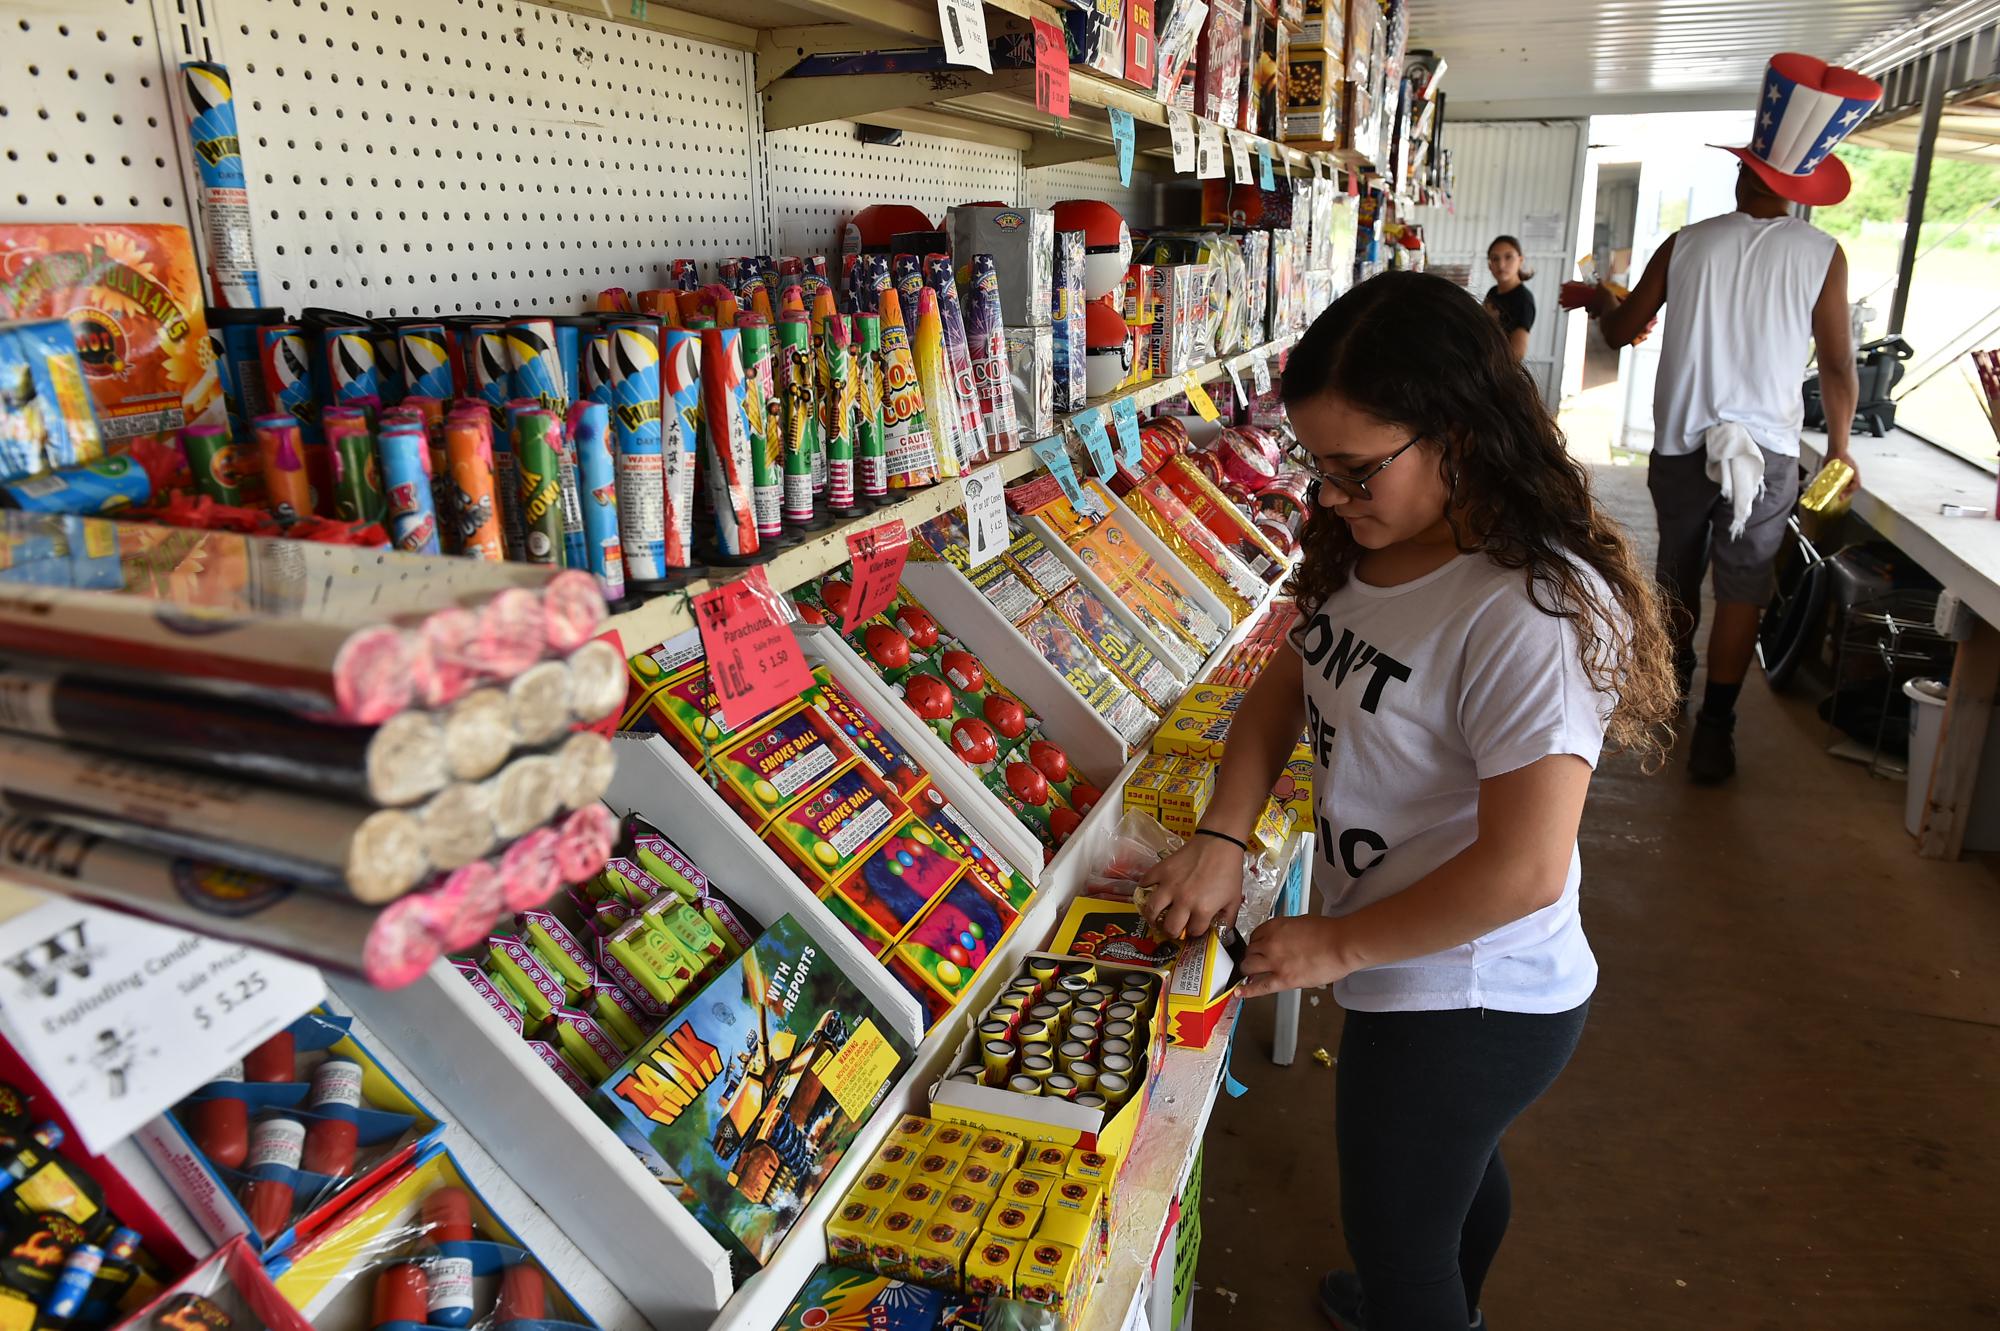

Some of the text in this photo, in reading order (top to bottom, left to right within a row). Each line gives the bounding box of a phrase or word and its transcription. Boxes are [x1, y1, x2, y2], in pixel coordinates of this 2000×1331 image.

[91, 244, 190, 342] FOUNTAINS
[724, 616, 772, 644] Parachutes
[1100, 632, 1128, 661] 50
[759, 650, 788, 673] $ 1.50
[820, 685, 894, 762] SMOKE BALL
[1202, 718, 1232, 742] BANG
[1307, 694, 1336, 769] BE
[759, 730, 819, 774] SMOKE BALL
[817, 786, 872, 834] SMOKE BALL
[177, 971, 208, 998] Sale
[766, 964, 791, 1003] WITH
[782, 944, 817, 1014] REPORTS
[42, 971, 144, 1035] Exploding
[194, 971, 268, 1031] $ 5.25
[613, 1020, 724, 1126] TANK
[835, 1038, 868, 1080] MOVES ON GROUND
[837, 1039, 858, 1065] WARNING
[181, 1152, 217, 1195] WARNING
